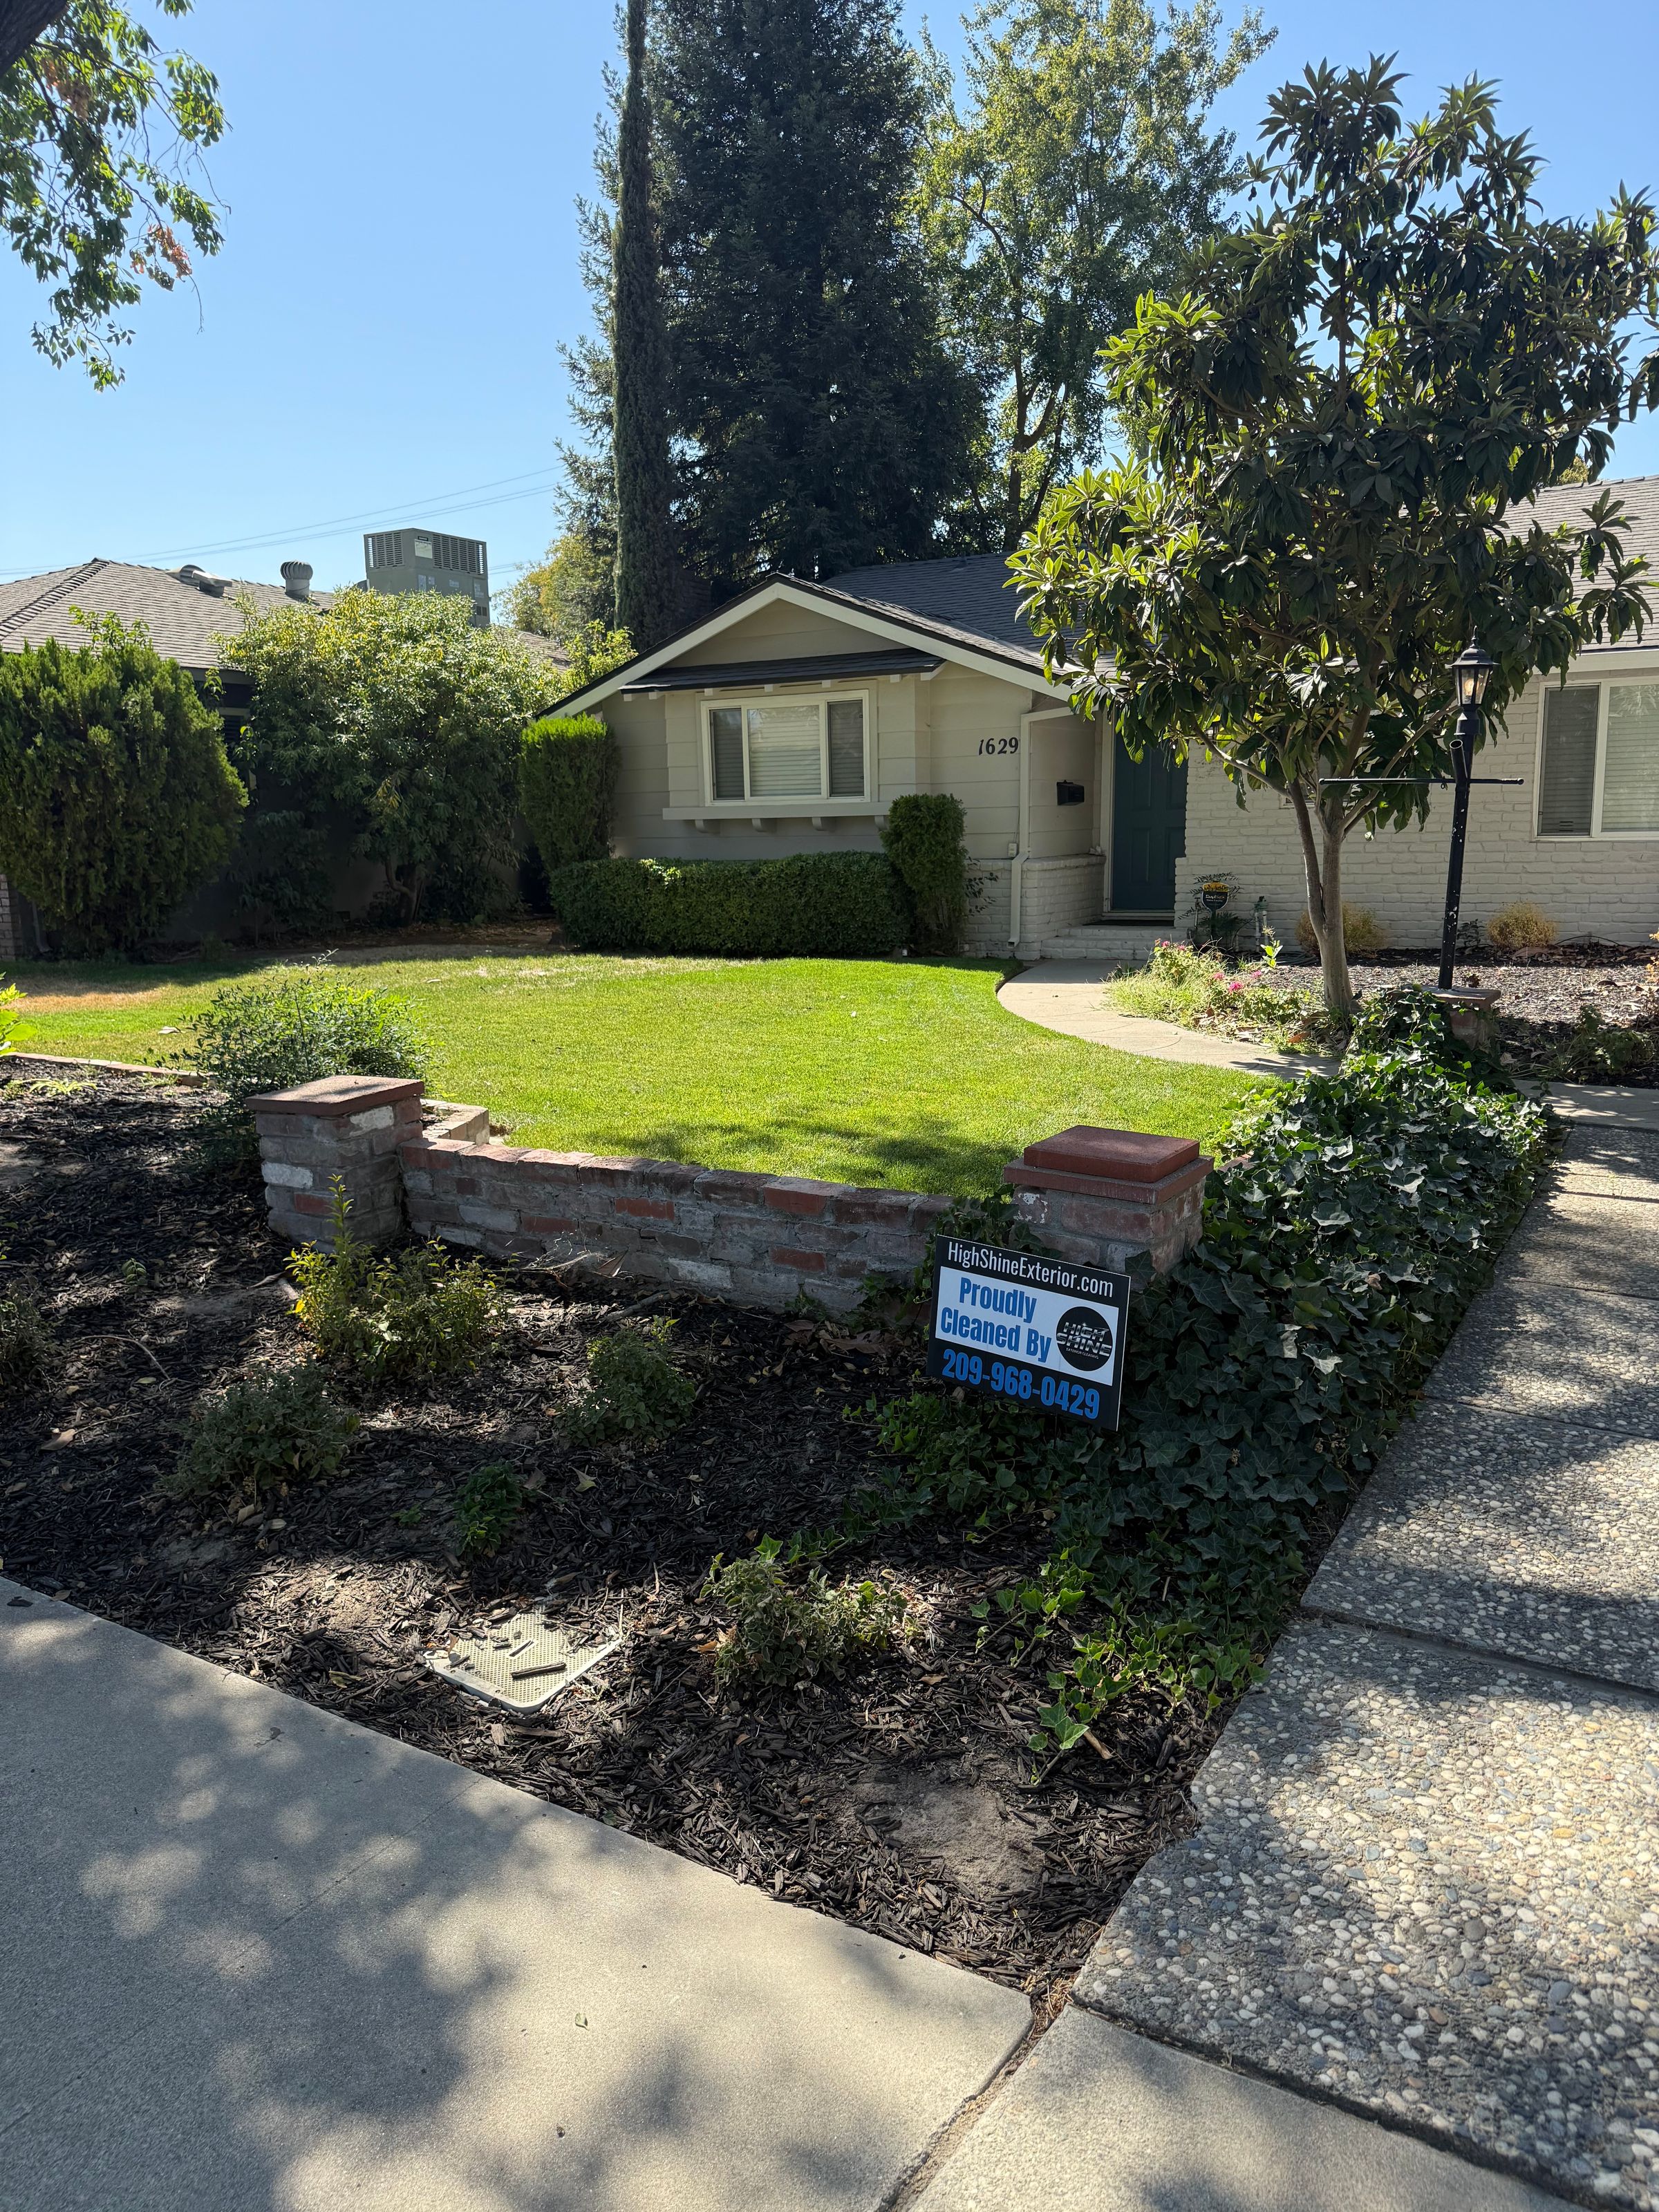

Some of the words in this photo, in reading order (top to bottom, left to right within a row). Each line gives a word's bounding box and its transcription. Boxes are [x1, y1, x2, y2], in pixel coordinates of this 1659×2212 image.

[978, 737, 1019, 756] 1629
[948, 1241, 1113, 1297] HighShineExterior.com
[959, 1277, 1037, 1324] Proudly
[941, 1307, 1021, 1352] Cleaned
[1026, 1328, 1052, 1363] By
[1056, 1332, 1112, 1357] SHINE
[1063, 1322, 1106, 1342] HIGH
[941, 1349, 1100, 1420] 209-968-0429
